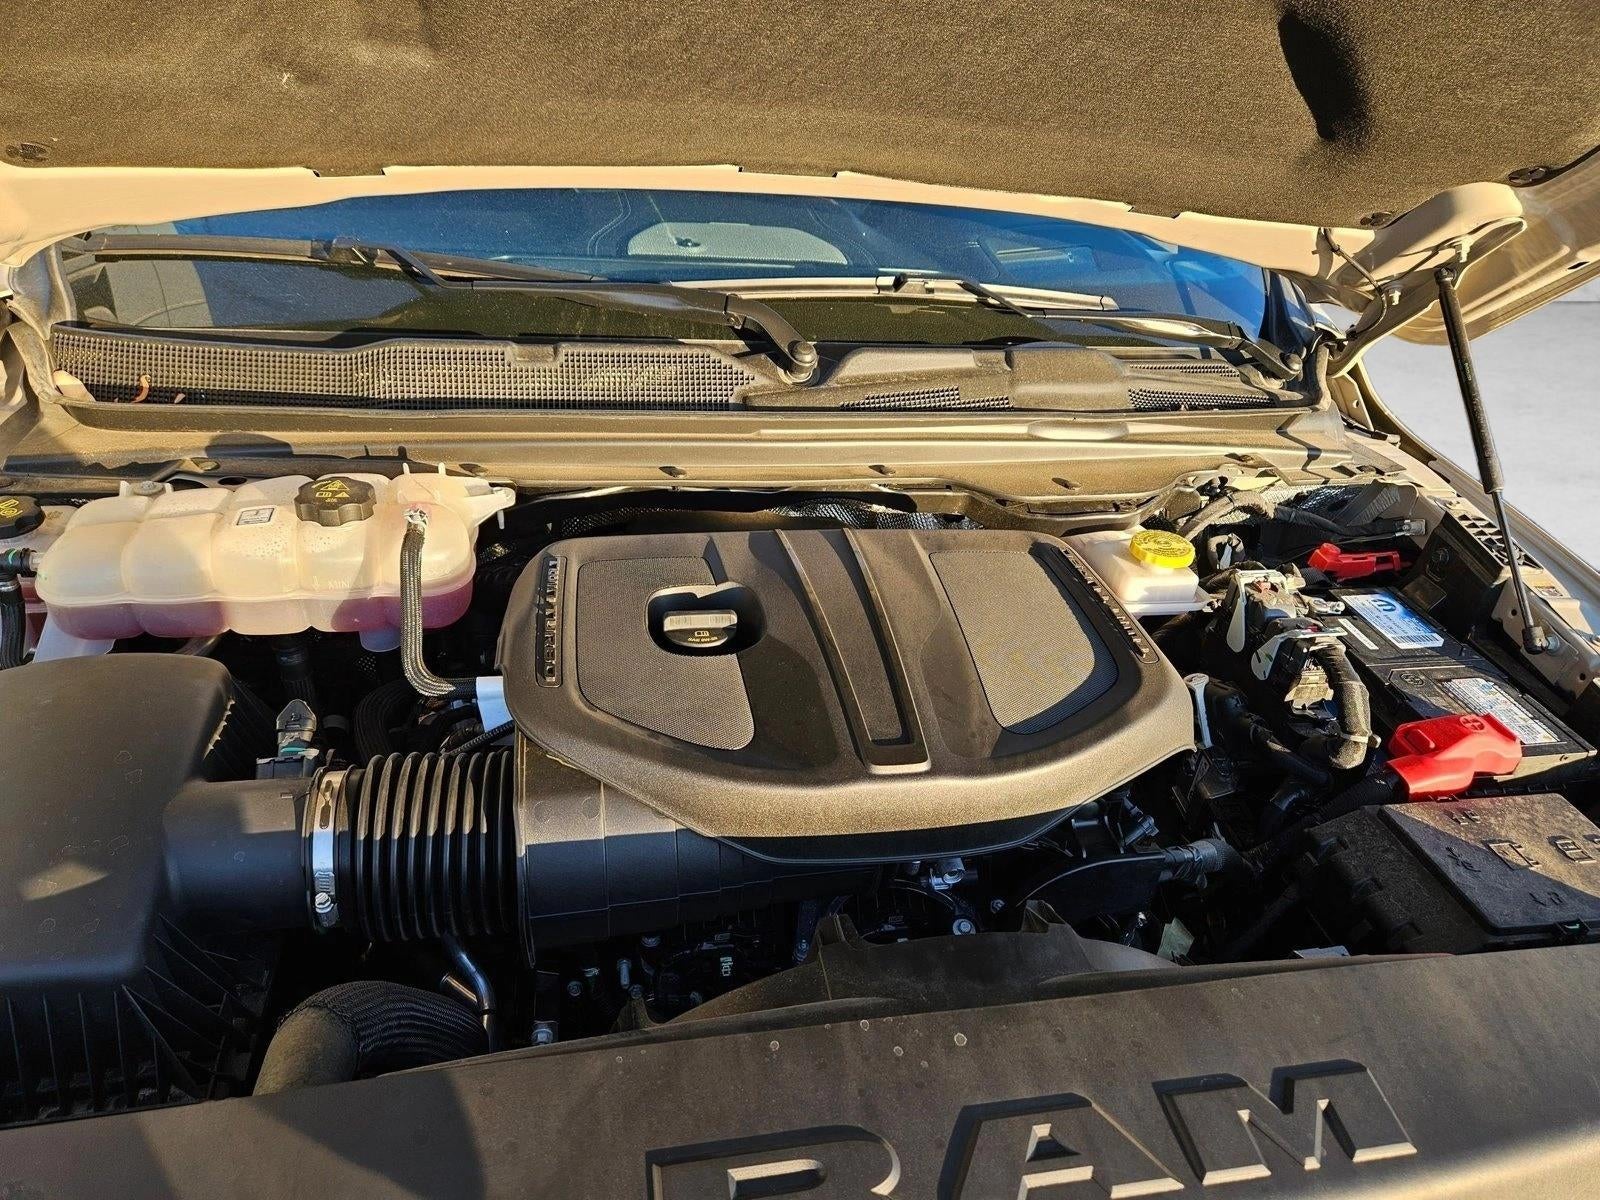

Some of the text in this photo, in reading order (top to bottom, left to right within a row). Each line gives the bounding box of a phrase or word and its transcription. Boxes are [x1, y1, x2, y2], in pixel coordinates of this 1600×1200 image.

[546, 560, 559, 682] TWIN TURBO
[646, 1059, 1419, 1200] RAM
